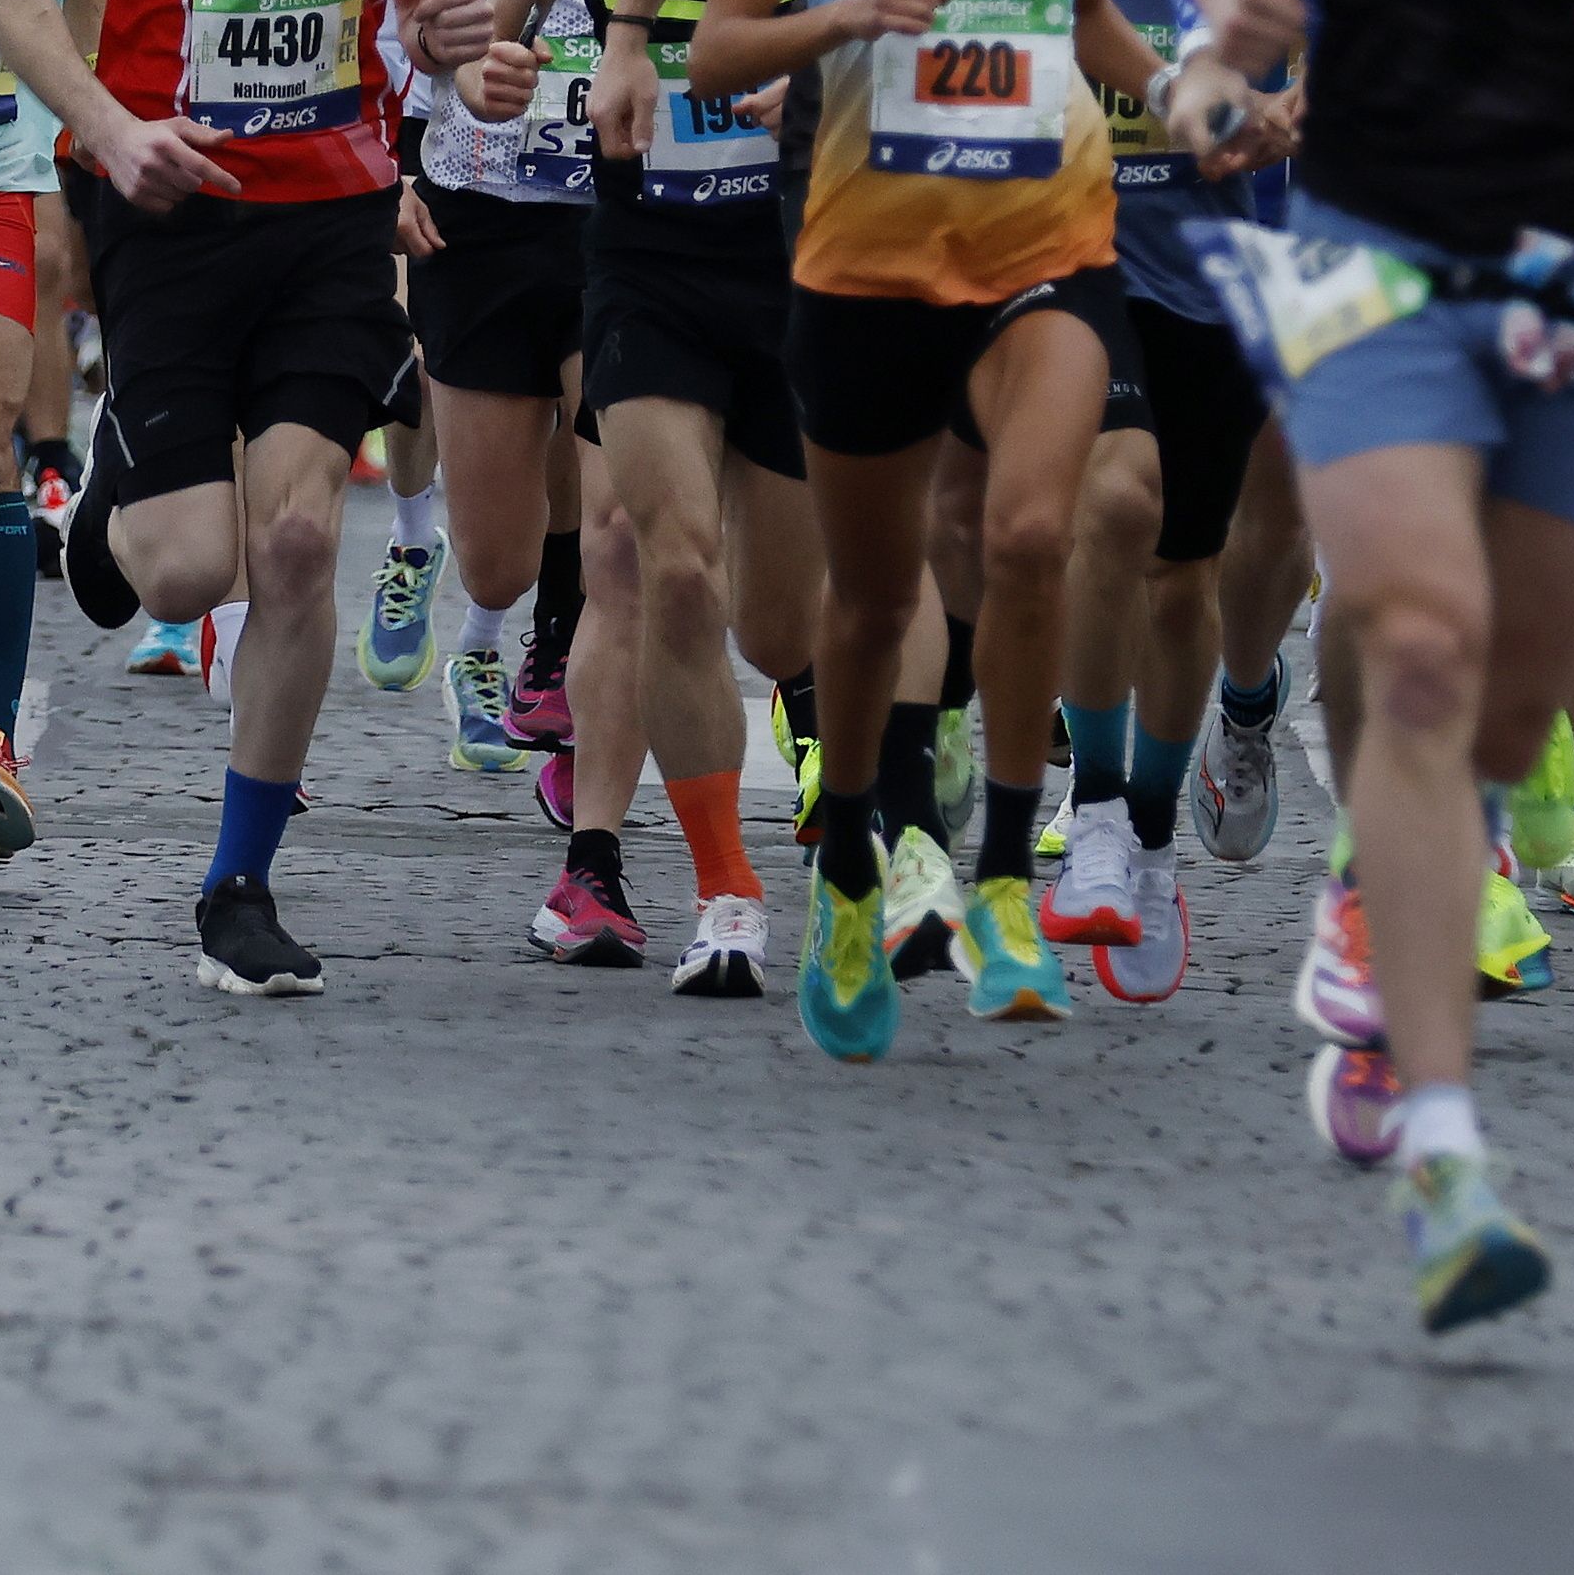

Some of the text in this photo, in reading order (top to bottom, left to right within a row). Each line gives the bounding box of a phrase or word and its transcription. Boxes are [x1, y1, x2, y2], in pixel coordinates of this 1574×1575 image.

[217, 12, 324, 68] 4430
[931, 38, 1016, 98] 220
[233, 79, 307, 99] Nathounet
[270, 106, 318, 129] asics
[956, 149, 1012, 170] asics
[717, 174, 770, 196] asics
[1118, 164, 1171, 184] asics
